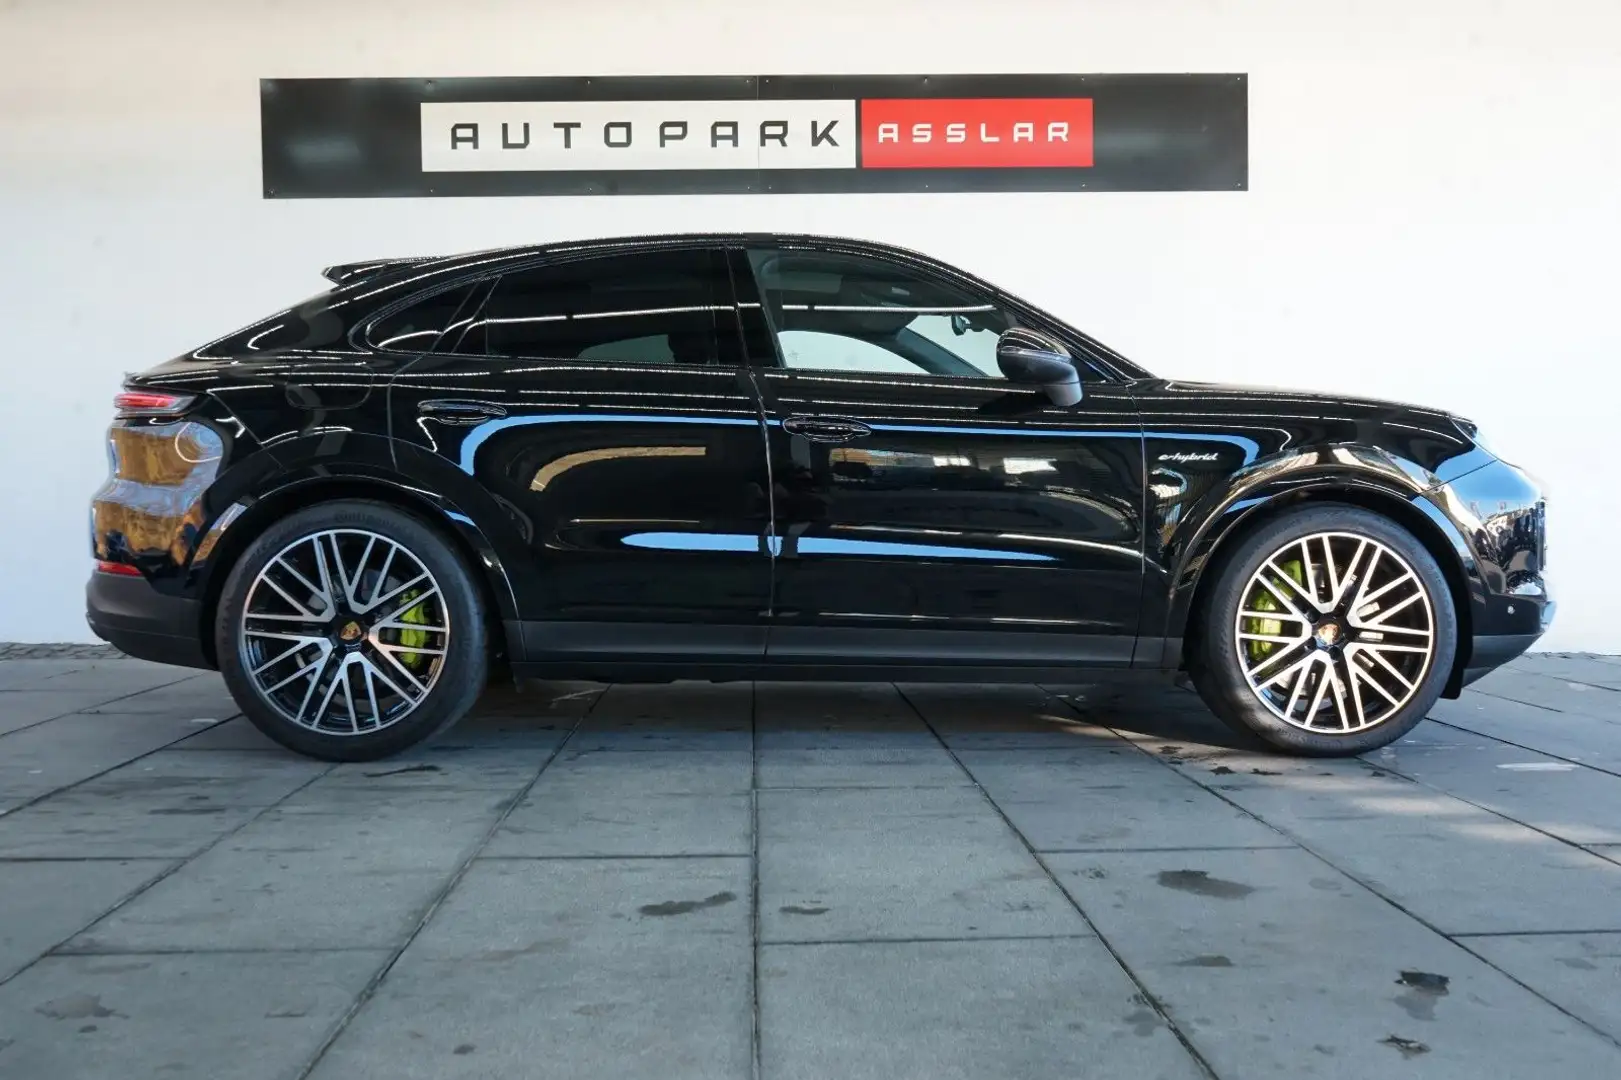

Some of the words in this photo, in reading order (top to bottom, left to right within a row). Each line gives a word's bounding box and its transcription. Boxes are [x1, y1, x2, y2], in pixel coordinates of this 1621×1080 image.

[451, 120, 839, 149] AUTOPARK
[878, 121, 1070, 144] ASSLAR
[1158, 452, 1219, 464] e-hybrid
